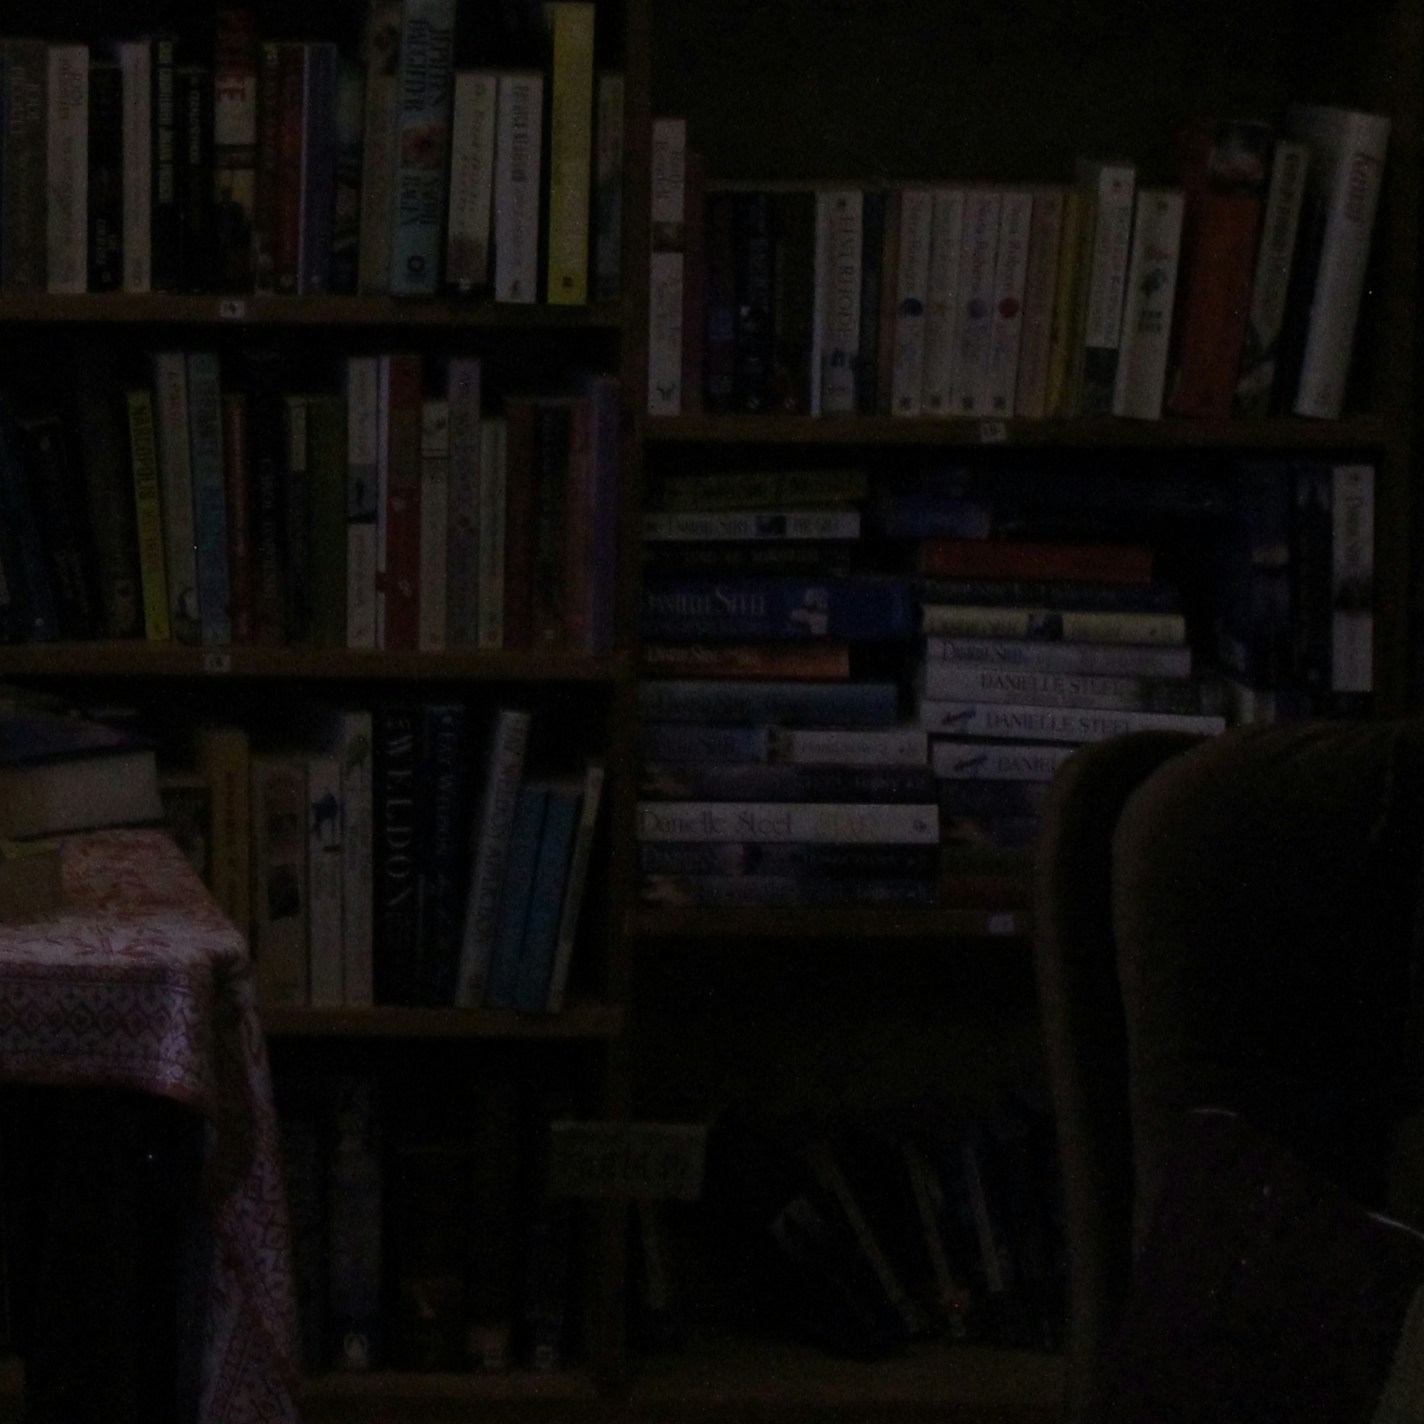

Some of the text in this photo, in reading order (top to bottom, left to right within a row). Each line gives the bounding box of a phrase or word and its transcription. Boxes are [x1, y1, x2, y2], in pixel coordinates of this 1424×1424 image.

[403, 19, 431, 112] DAUGHTER
[132, 405, 155, 501] NARCOPOLIS
[980, 673, 1062, 693] DANIELLE
[985, 711, 1071, 732] DANIELLE
[386, 731, 414, 910] WELDON
[640, 809, 729, 837] Danielle
[735, 811, 795, 838] Steel
